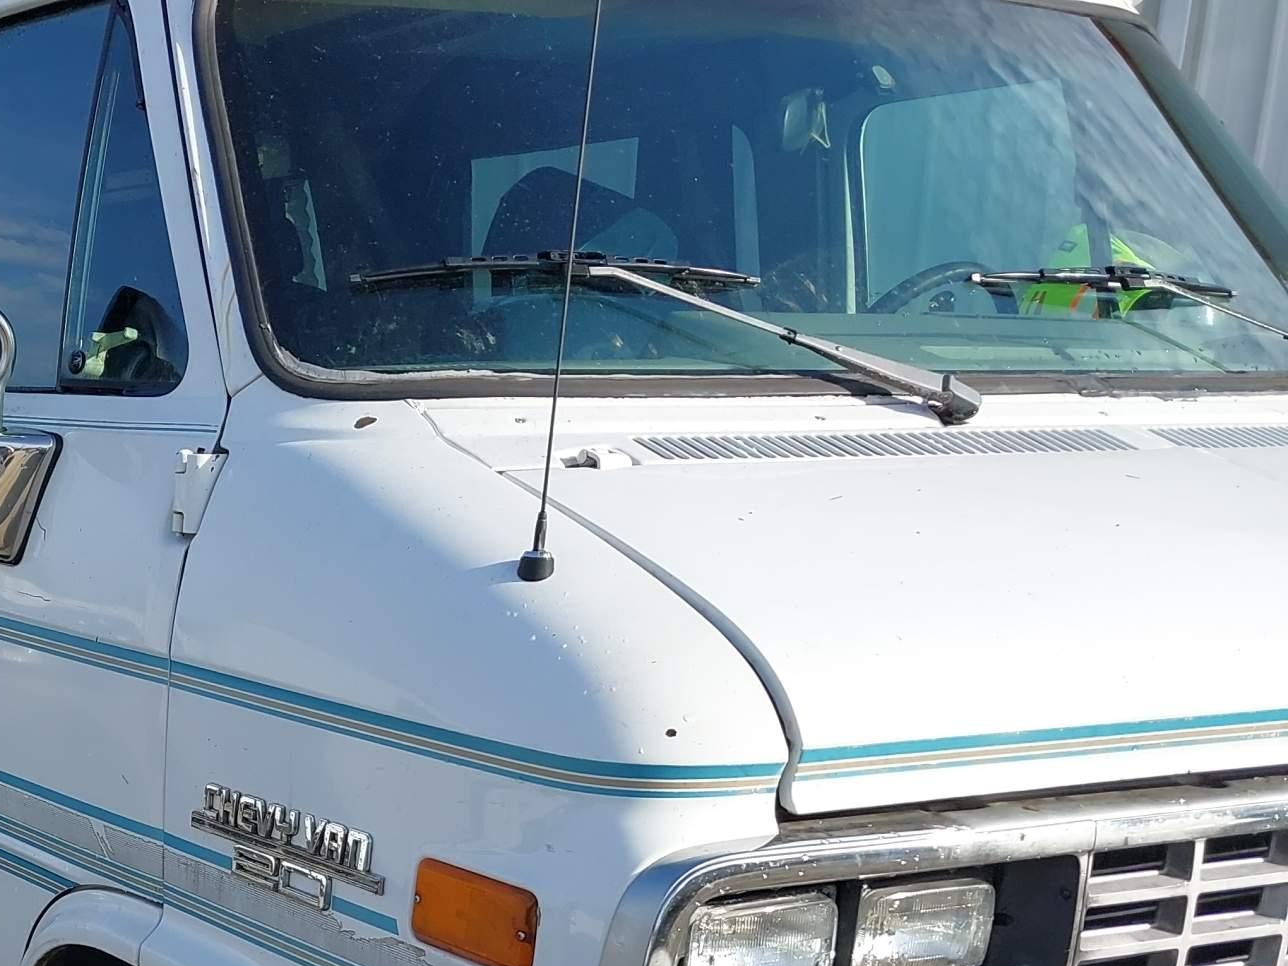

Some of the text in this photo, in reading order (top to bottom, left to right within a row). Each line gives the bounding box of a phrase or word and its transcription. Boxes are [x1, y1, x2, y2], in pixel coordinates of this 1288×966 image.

[204, 782, 374, 875] CHEVY VAN
[232, 844, 333, 912] 20
